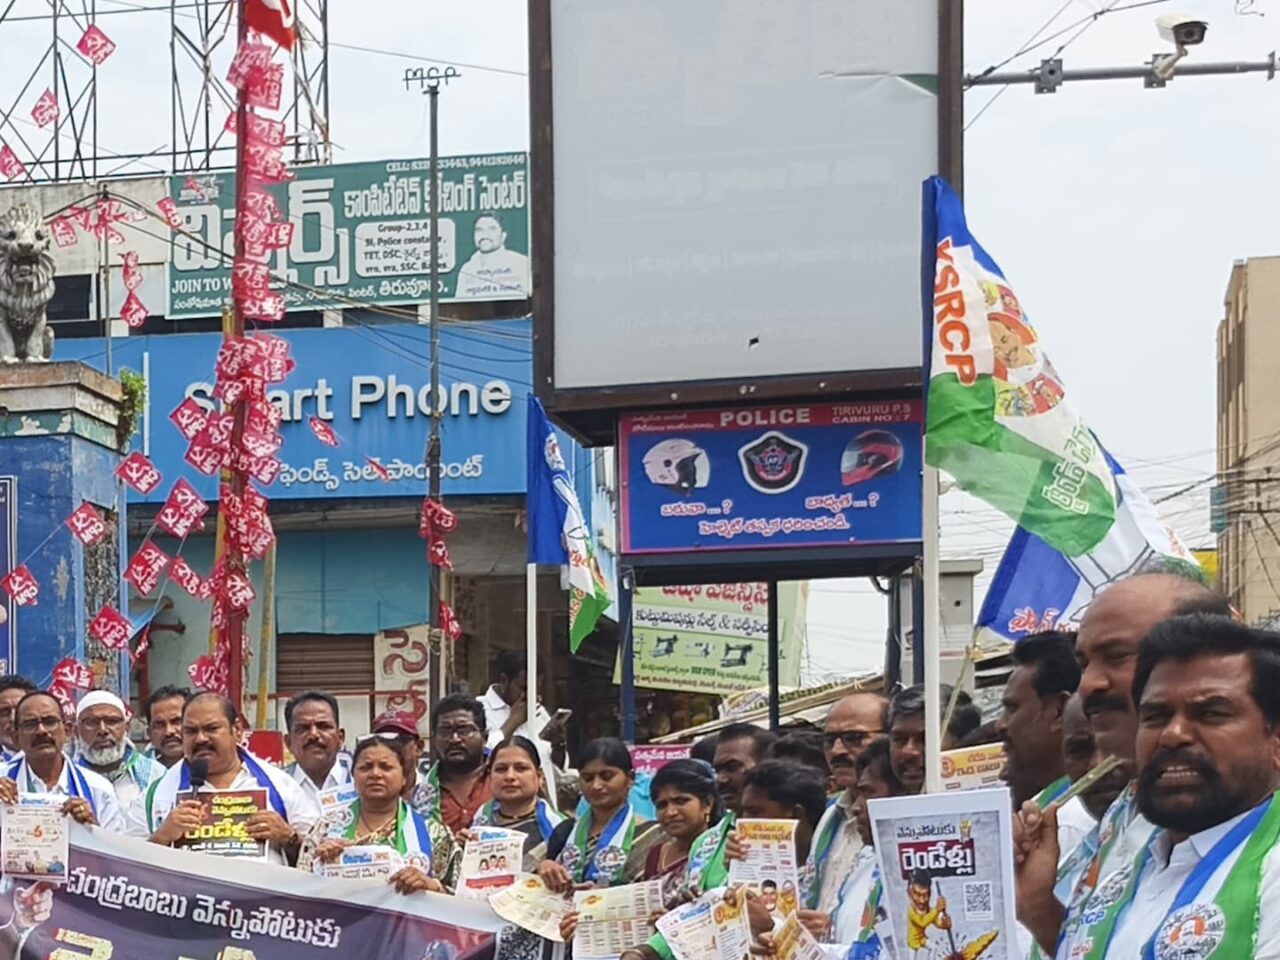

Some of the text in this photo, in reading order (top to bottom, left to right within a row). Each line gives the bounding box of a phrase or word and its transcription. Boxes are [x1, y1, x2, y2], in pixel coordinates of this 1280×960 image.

[172, 278, 201, 294] JOIN
[203, 278, 219, 292] TO
[185, 375, 512, 421] Sart Phone
[720, 408, 811, 427] POLICE
[832, 415, 870, 424] CABIN
[67, 867, 188, 919] చంద్రబాబు
